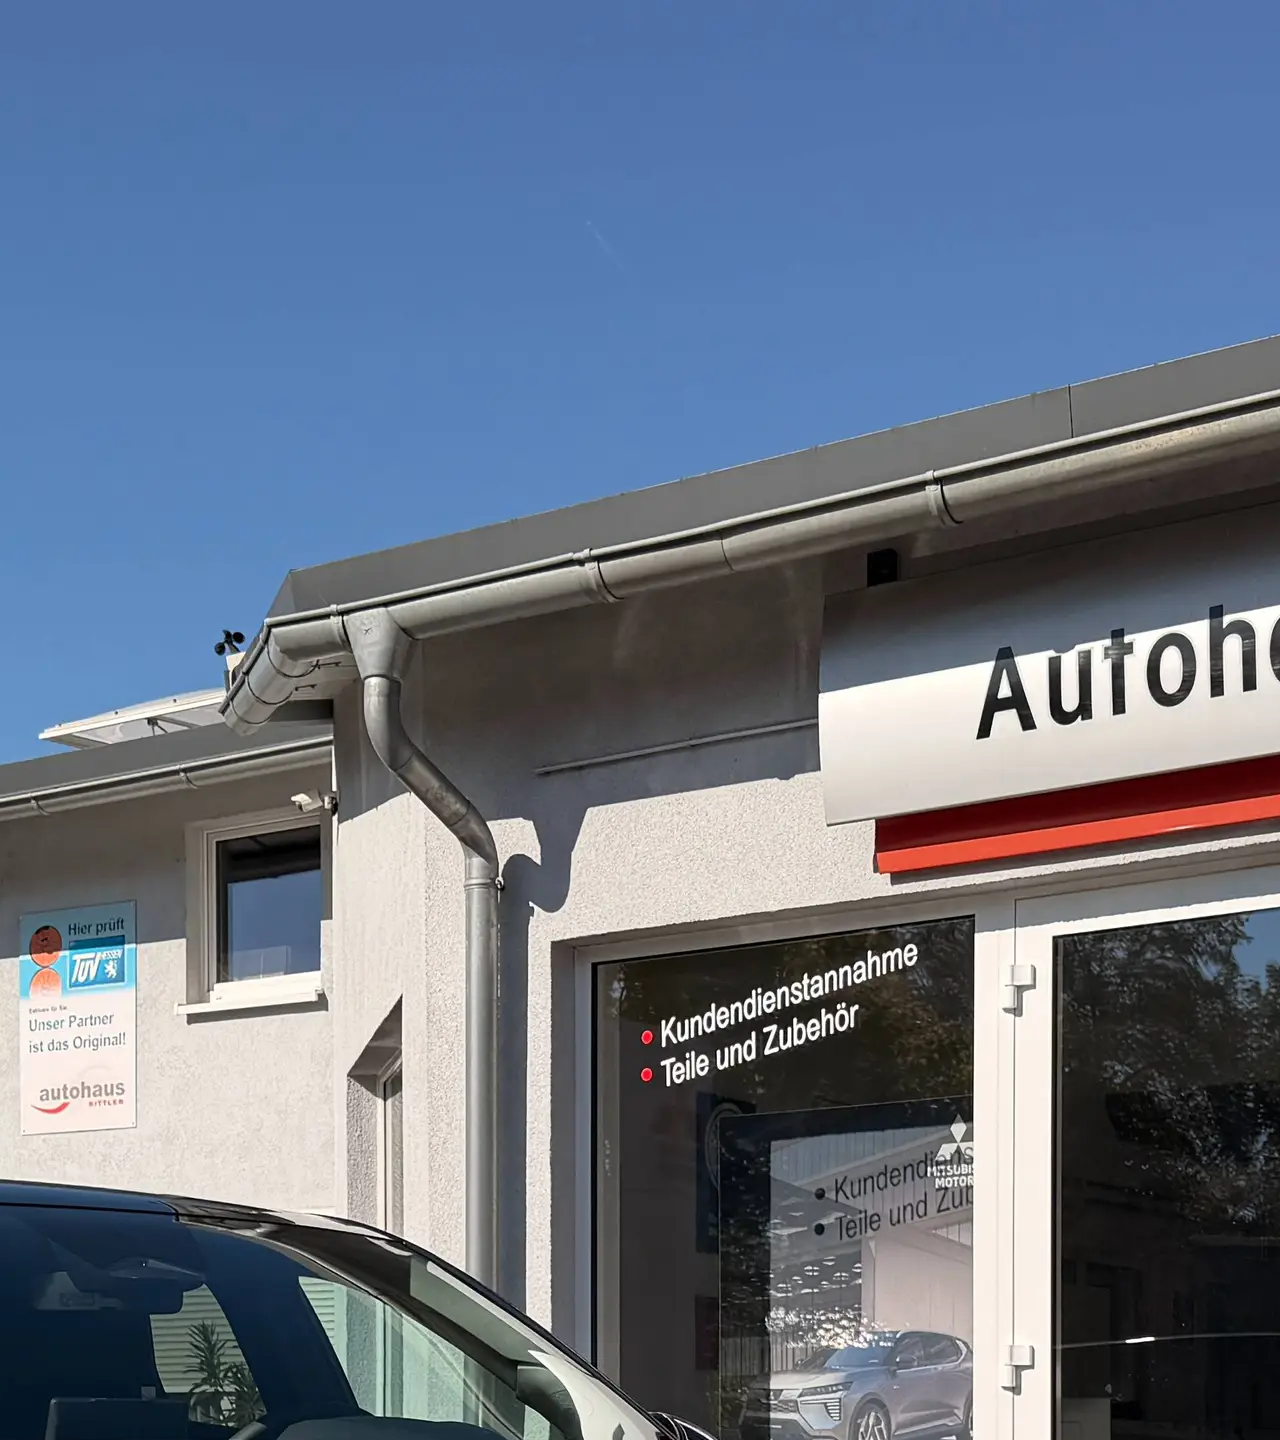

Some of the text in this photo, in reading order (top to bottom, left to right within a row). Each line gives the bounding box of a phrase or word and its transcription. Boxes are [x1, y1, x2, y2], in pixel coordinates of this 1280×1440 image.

[68, 918, 125, 936] Hier prüft
[660, 943, 919, 1048] Kundendienstannahme
[29, 1014, 114, 1032] Unser Partner
[29, 1032, 126, 1054] ist das Original!
[660, 1002, 860, 1087] Teile und Zubehör
[39, 1081, 126, 1102] autohaus
[835, 1208, 882, 1241] Teile
[889, 1191, 928, 1227] und
